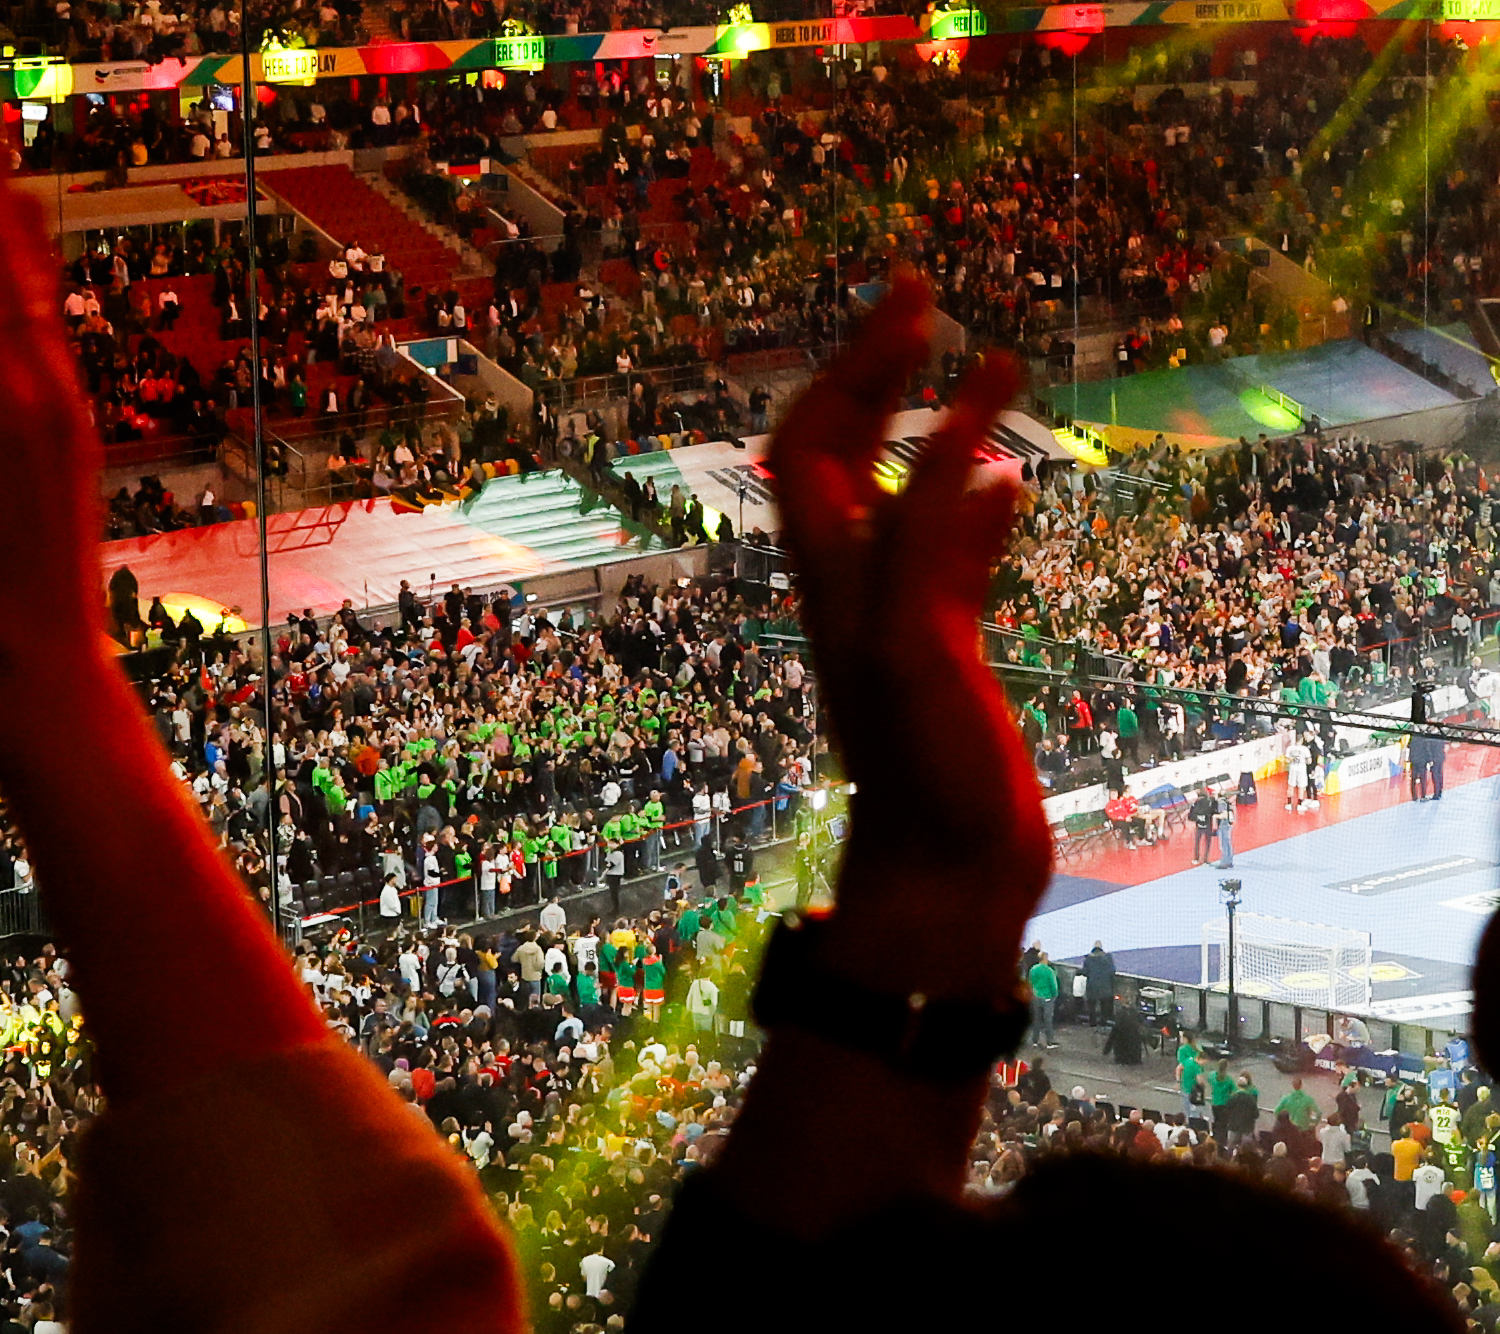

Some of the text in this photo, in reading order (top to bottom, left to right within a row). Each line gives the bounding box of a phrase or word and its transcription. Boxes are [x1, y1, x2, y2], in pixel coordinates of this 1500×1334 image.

[1195, 3, 1262, 19] HERE TO PLAY
[1447, 0, 1461, 15] TO
[775, 23, 832, 44] HERE TO PLAY
[516, 43, 529, 61] TO
[264, 54, 337, 76] HERE TO PLAY
[1436, 1116, 1451, 1129] 22
